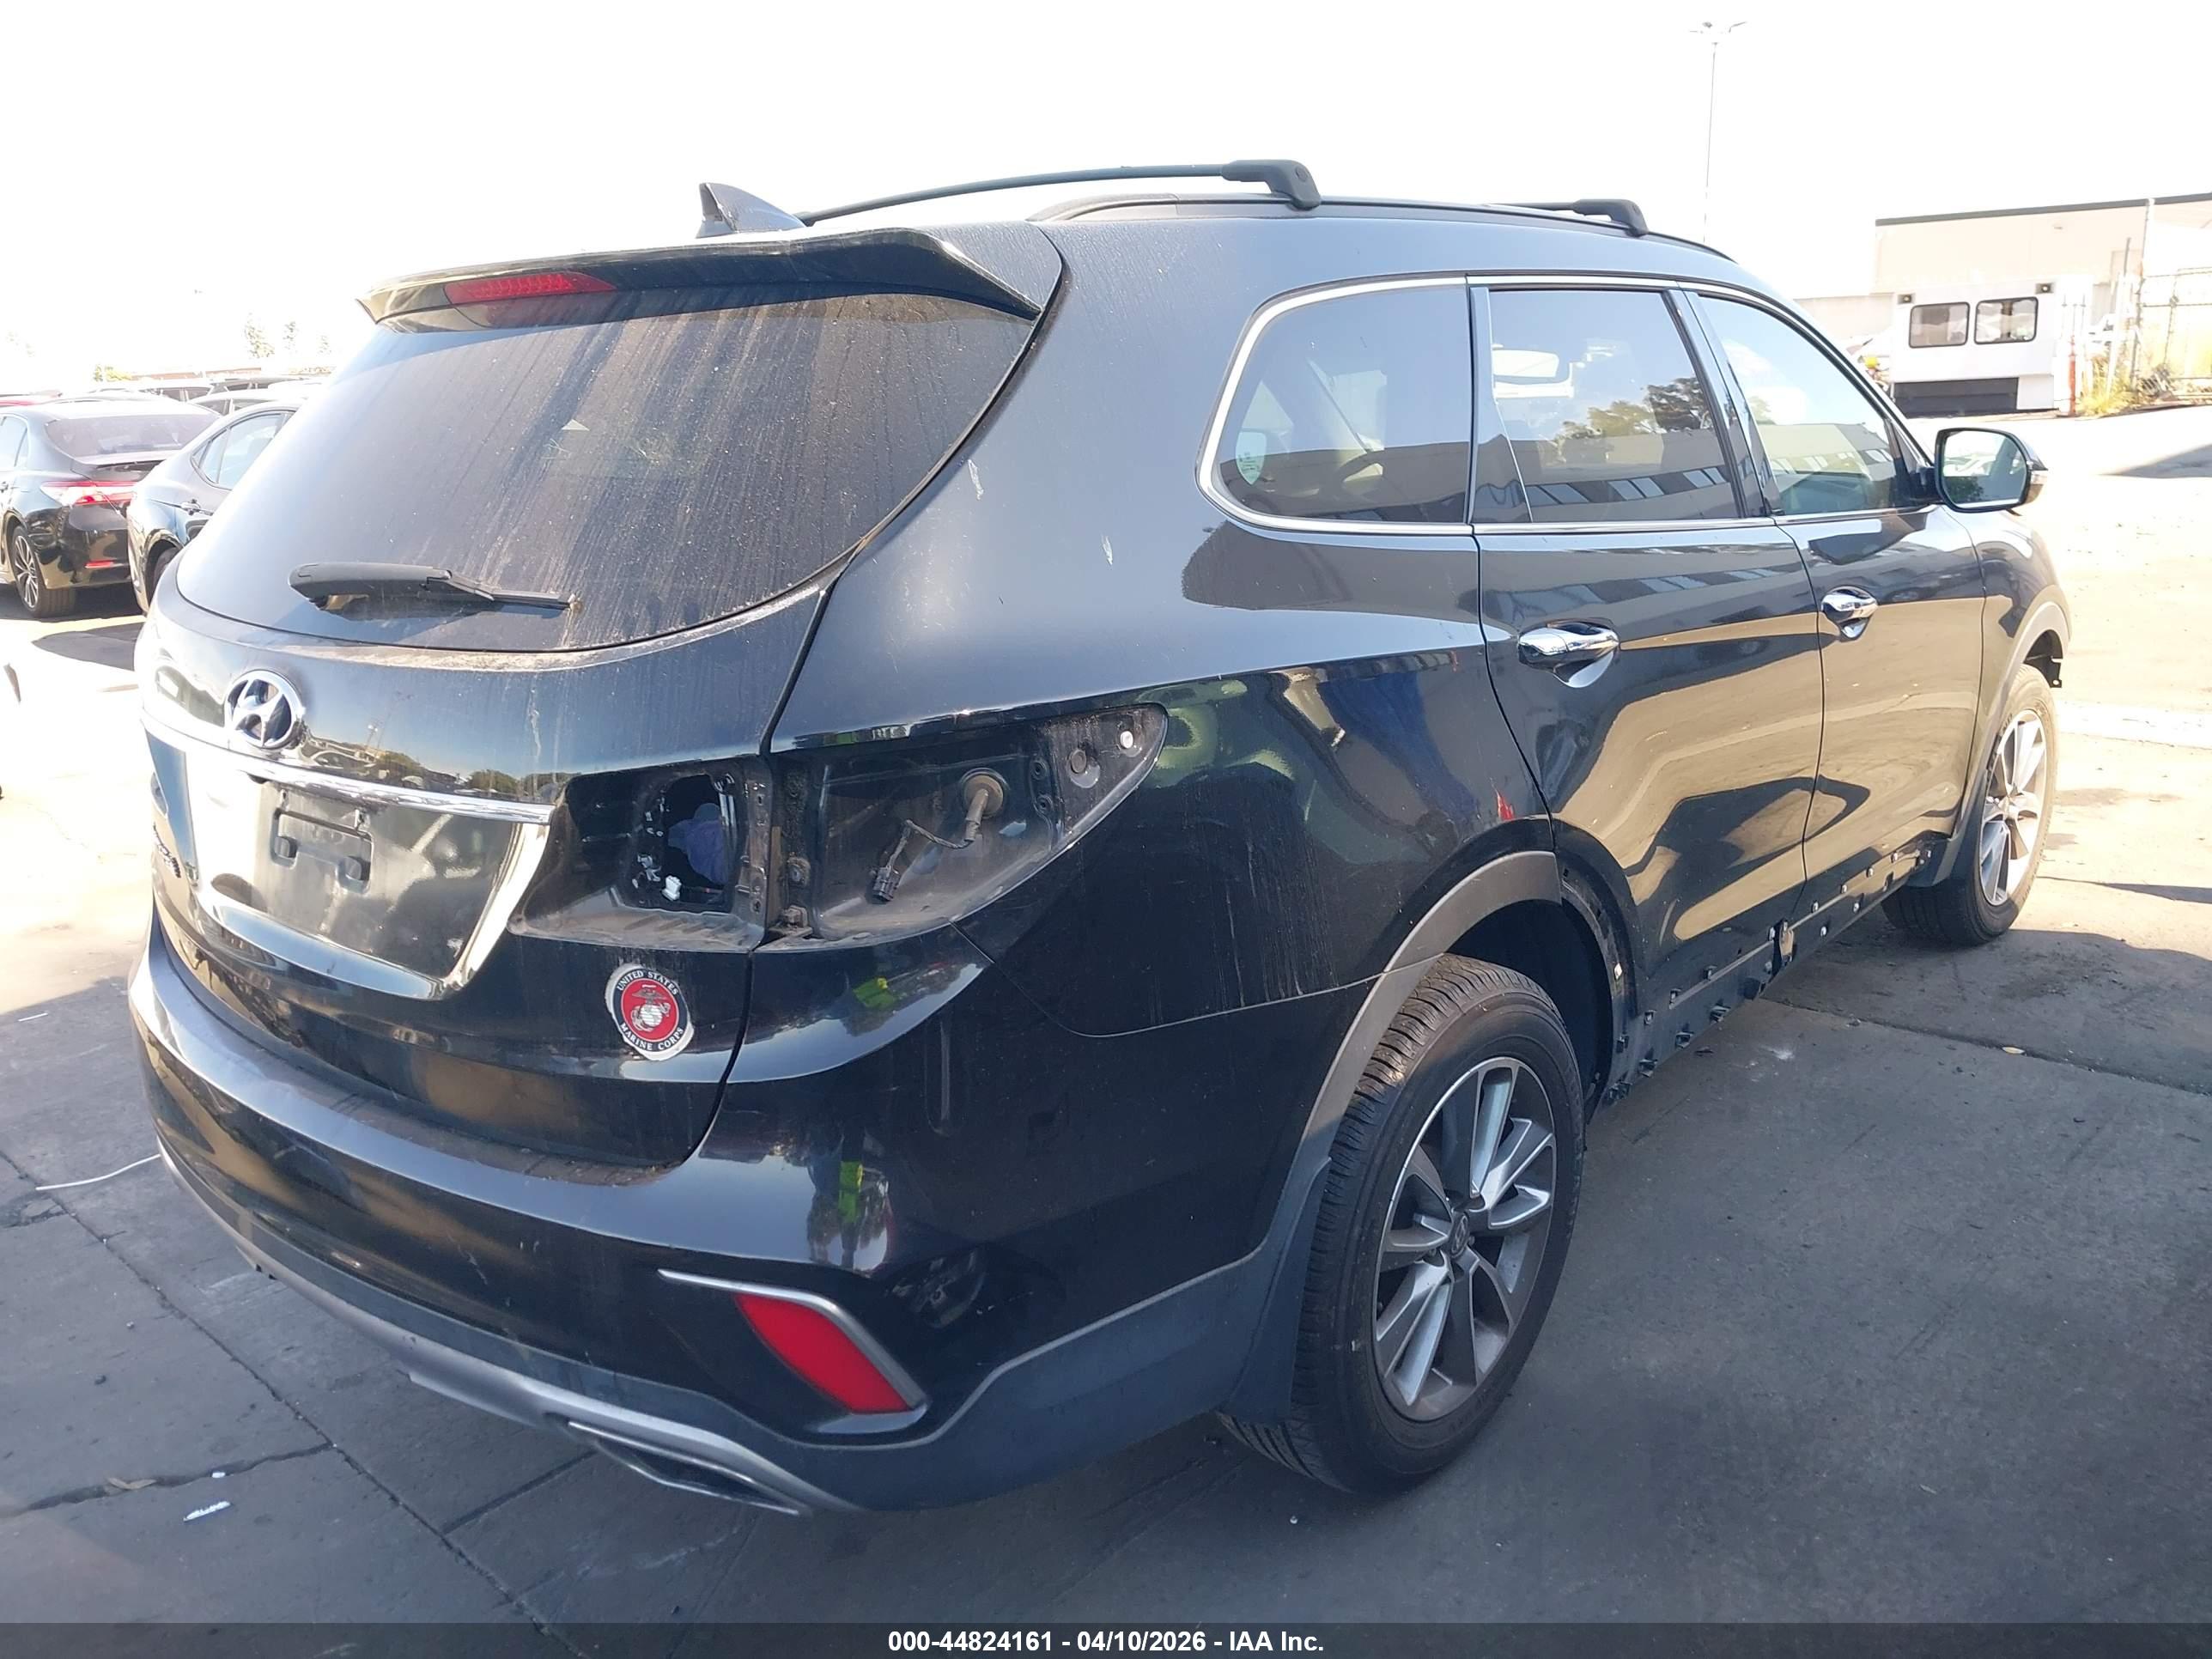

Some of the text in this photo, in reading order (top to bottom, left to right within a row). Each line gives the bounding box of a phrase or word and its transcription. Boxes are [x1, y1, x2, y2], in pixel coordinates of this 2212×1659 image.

[617, 970, 678, 995] UNITED STATES
[620, 1023, 684, 1050] MARINE CORPS
